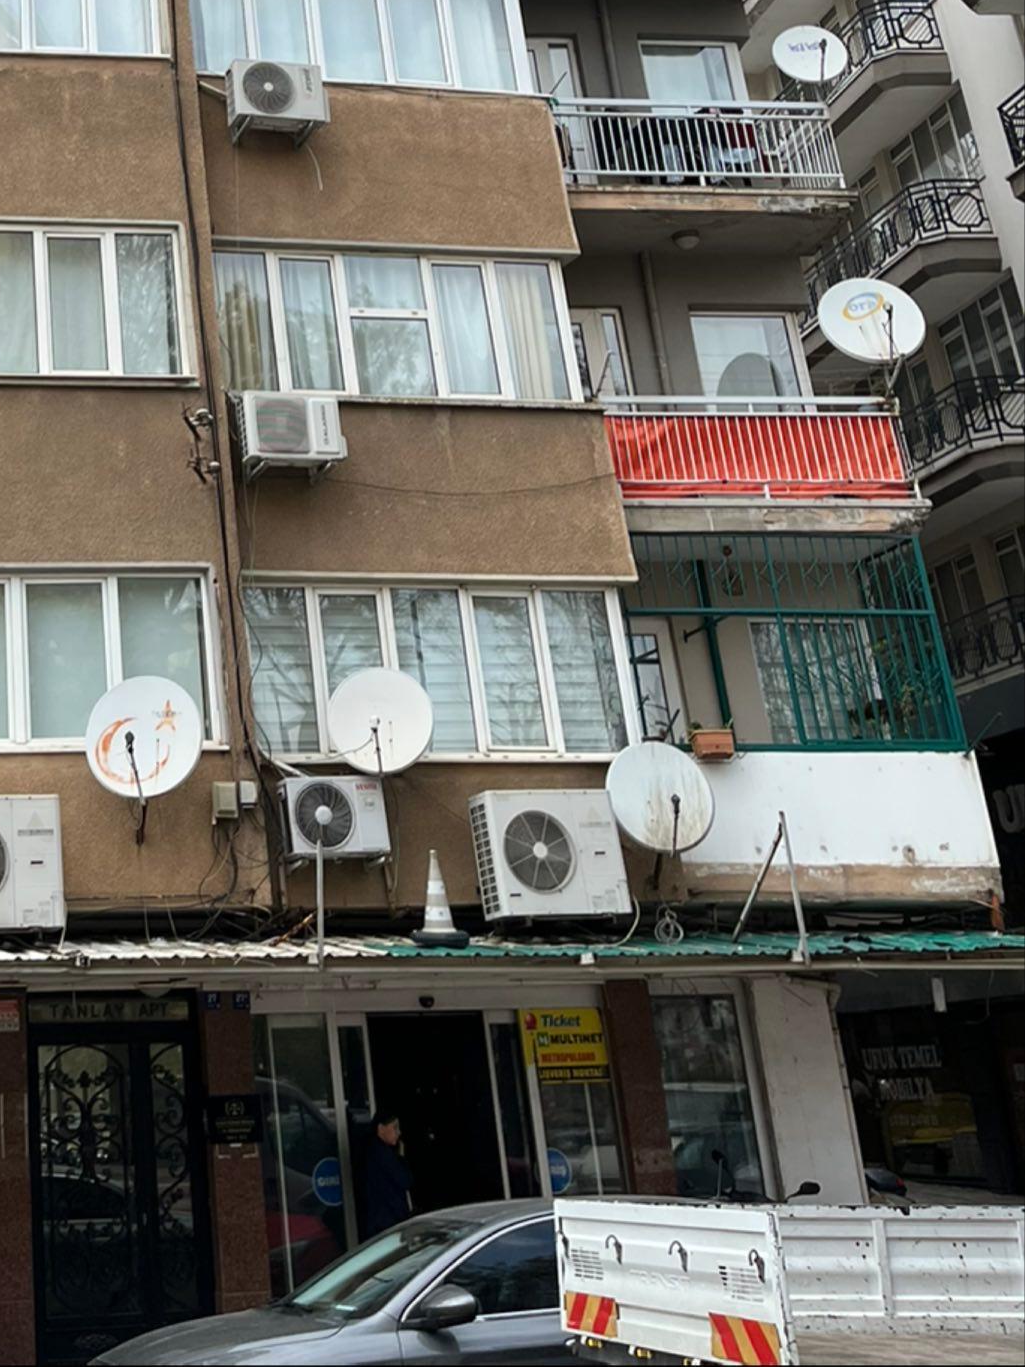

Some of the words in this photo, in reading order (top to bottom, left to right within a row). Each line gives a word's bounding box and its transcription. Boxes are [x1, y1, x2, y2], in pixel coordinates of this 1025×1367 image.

[49, 1001, 125, 1019] TANLAY
[137, 1001, 170, 1019] APT
[540, 1013, 581, 1027] Ticket
